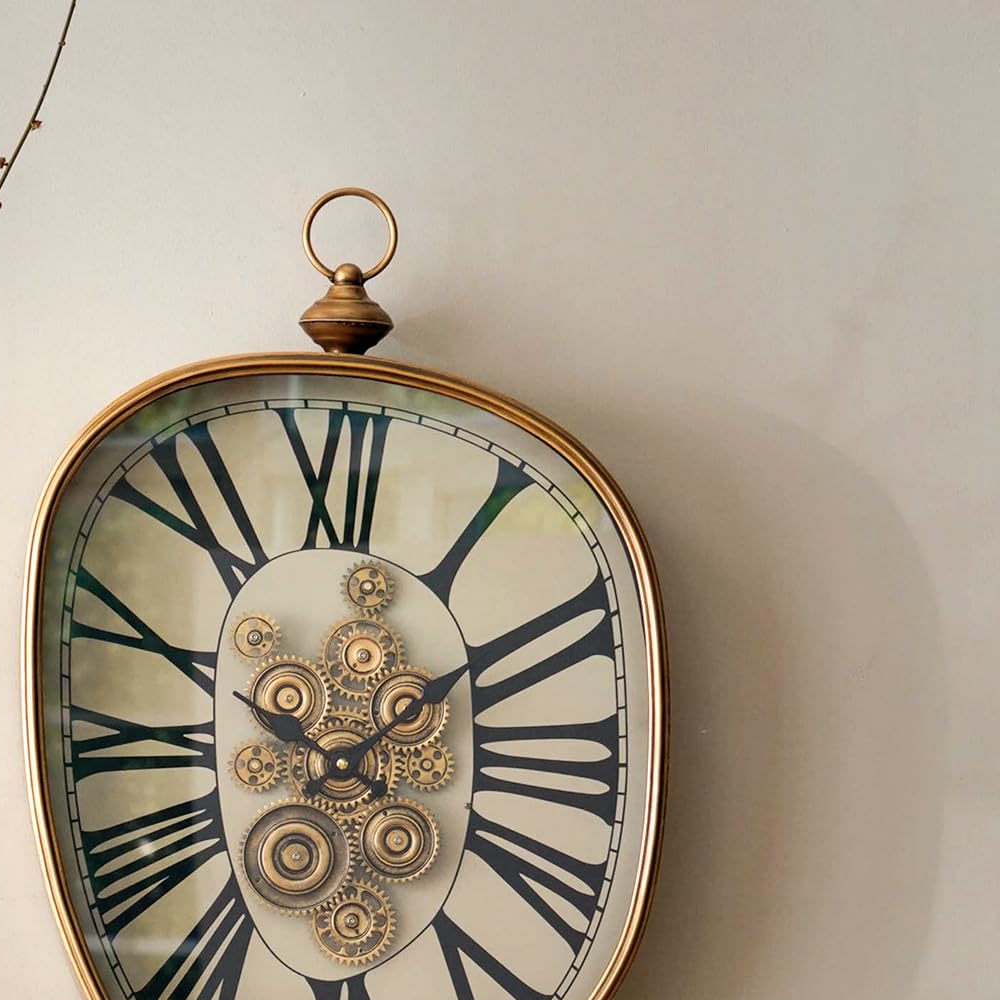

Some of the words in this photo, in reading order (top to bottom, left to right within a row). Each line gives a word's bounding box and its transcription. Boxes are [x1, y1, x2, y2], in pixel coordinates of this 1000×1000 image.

[110, 421, 269, 601] XI
[274, 409, 392, 554] XII
[416, 457, 535, 607] I
[71, 565, 217, 698] X
[465, 566, 614, 719] II
[70, 704, 217, 784] IX
[472, 713, 617, 827] III
[81, 785, 233, 942] VIII
[464, 809, 607, 957] IV
